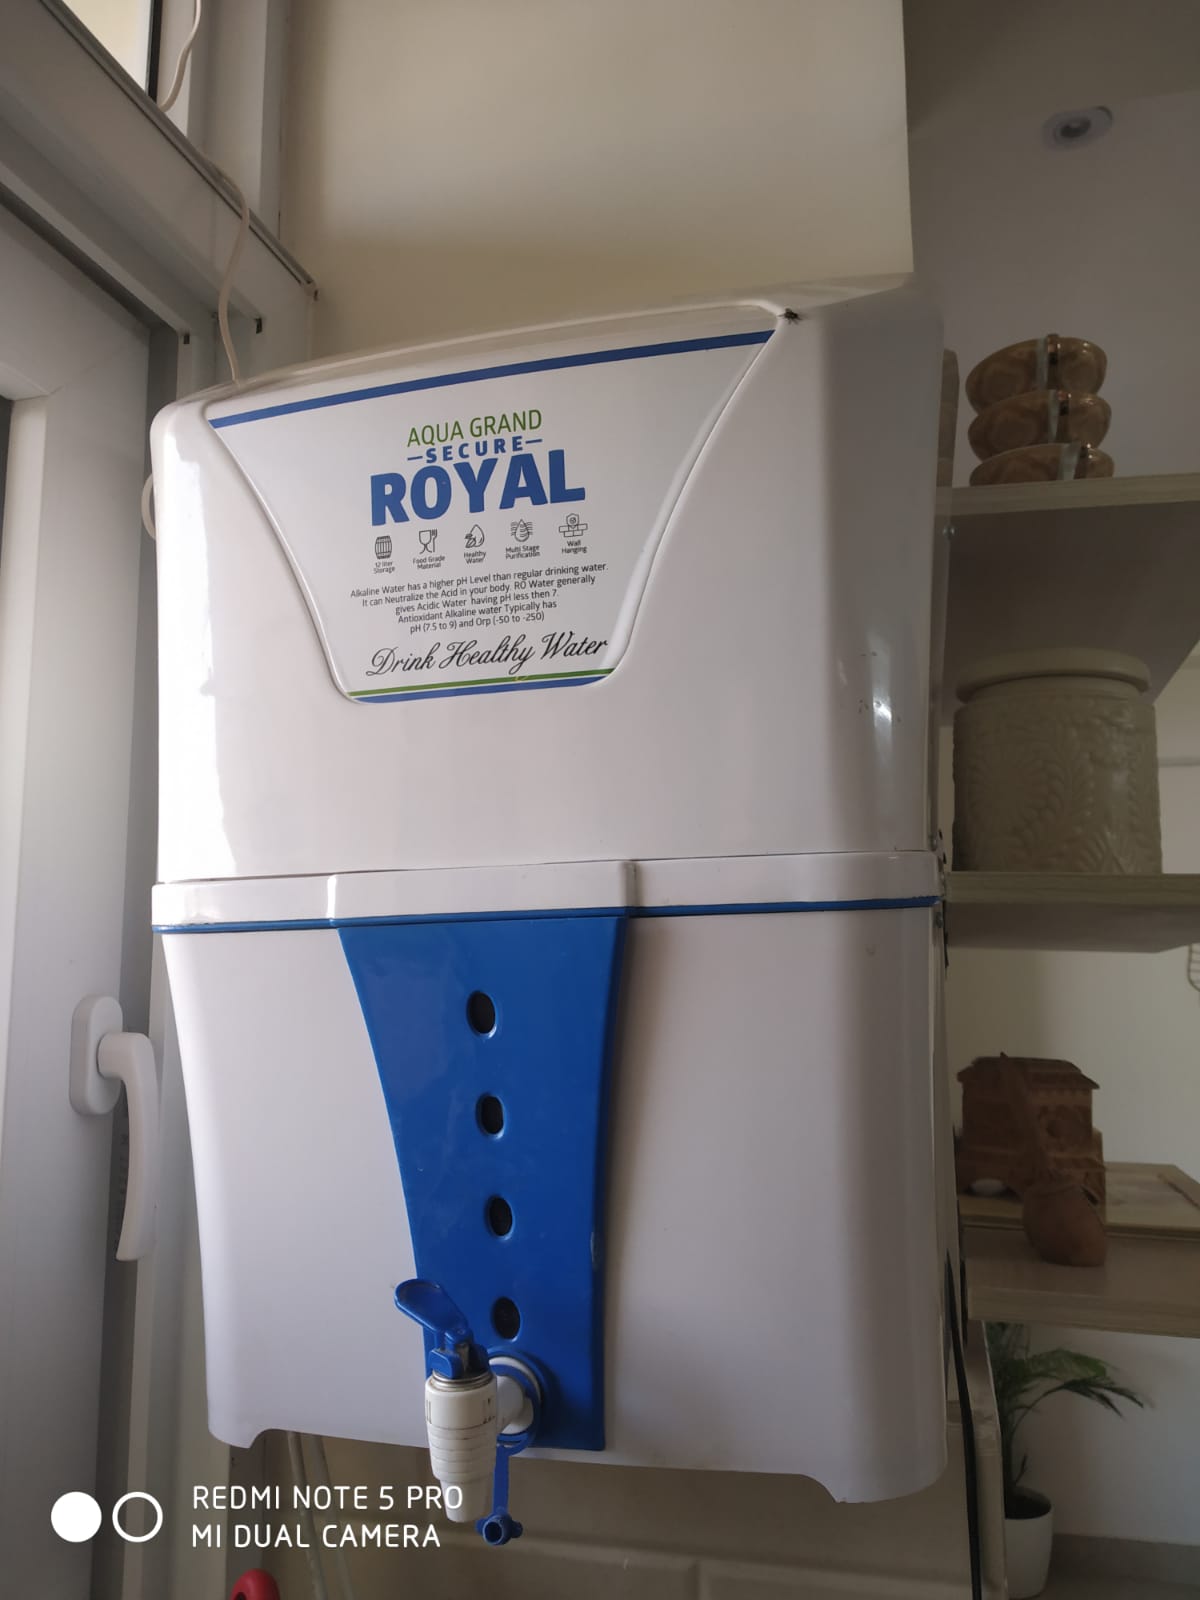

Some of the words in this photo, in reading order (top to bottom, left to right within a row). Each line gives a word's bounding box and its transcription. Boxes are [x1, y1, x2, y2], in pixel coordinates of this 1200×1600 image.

[407, 421, 464, 447] AQUA
[470, 409, 542, 438] GRAND
[426, 435, 523, 464] SECURE
[370, 449, 586, 527] ROYAL
[464, 550, 486, 559] Healthy
[505, 551, 541, 560] Purification
[561, 546, 587, 555] Hanging
[373, 566, 396, 574] Storage
[417, 562, 441, 570] Material
[350, 587, 380, 598] Alkaline
[382, 584, 405, 594] Water
[407, 582, 421, 592] has
[429, 579, 455, 591] higher
[456, 576, 468, 587] pH
[469, 573, 490, 584] Level
[493, 572, 511, 581] than
[514, 568, 542, 580] regular
[545, 565, 579, 577] drinking
[581, 563, 608, 573] water.
[362, 598, 368, 607] It
[369, 598, 383, 607] can
[385, 593, 424, 604] Neutralize
[426, 590, 438, 599] the
[441, 588, 458, 598] Acid
[460, 587, 467, 596] in
[469, 585, 487, 597] your
[514, 581, 526, 590] RO
[528, 578, 554, 589] Water
[556, 574, 595, 588] generally
[395, 604, 415, 615] gives
[417, 601, 440, 611] Acidic
[442, 598, 467, 609] Water
[471, 594, 498, 605] having
[500, 592, 511, 604] pH
[513, 592, 529, 601] less
[531, 590, 550, 599] then
[398, 611, 442, 623] Antioxidant
[444, 608, 476, 619] Alkaline
[478, 606, 502, 615] water
[504, 601, 541, 614] Typically
[542, 600, 557, 609] has
[410, 624, 421, 635] pH
[422, 622, 437, 632] (7.5
[439, 622, 447, 630] to
[449, 619, 457, 630] 9)
[459, 618, 474, 628] and
[476, 617, 491, 627] Orp
[492, 615, 510, 625] (-50
[511, 614, 520, 622] to
[522, 611, 545, 622] -250)
[366, 642, 441, 677] Drink
[438, 633, 535, 675] Healthy
[540, 631, 608, 661] Water
